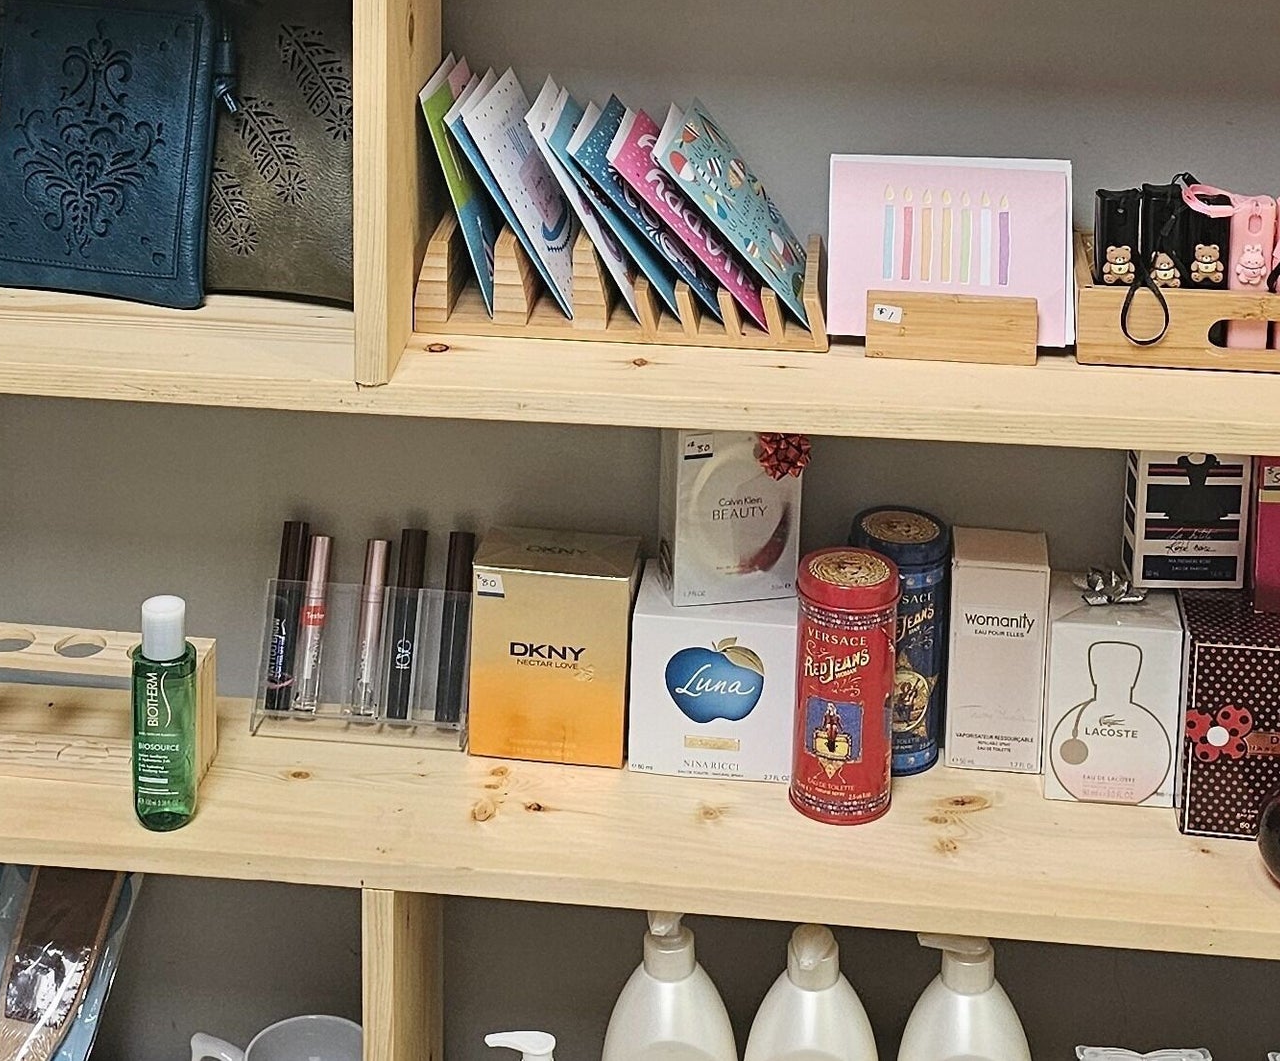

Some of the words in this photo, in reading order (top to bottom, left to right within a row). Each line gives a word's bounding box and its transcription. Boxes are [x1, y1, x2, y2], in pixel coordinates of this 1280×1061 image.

[718, 497, 744, 508] Calvin
[744, 496, 763, 505] Klein
[712, 506, 769, 521] BEAUTY
[965, 612, 1036, 634] womanity
[807, 626, 868, 646] VERSACE
[510, 642, 586, 662] DKNY
[516, 658, 553, 669] NECTAR
[555, 661, 578, 670] LOVE
[675, 664, 755, 697] Luna
[146, 672, 159, 727] BIOTHERM
[1085, 727, 1138, 738] LACOSTE
[138, 743, 180, 752] BIOSOURCE
[683, 760, 708, 770] NINA
[710, 761, 740, 772] RICCI
